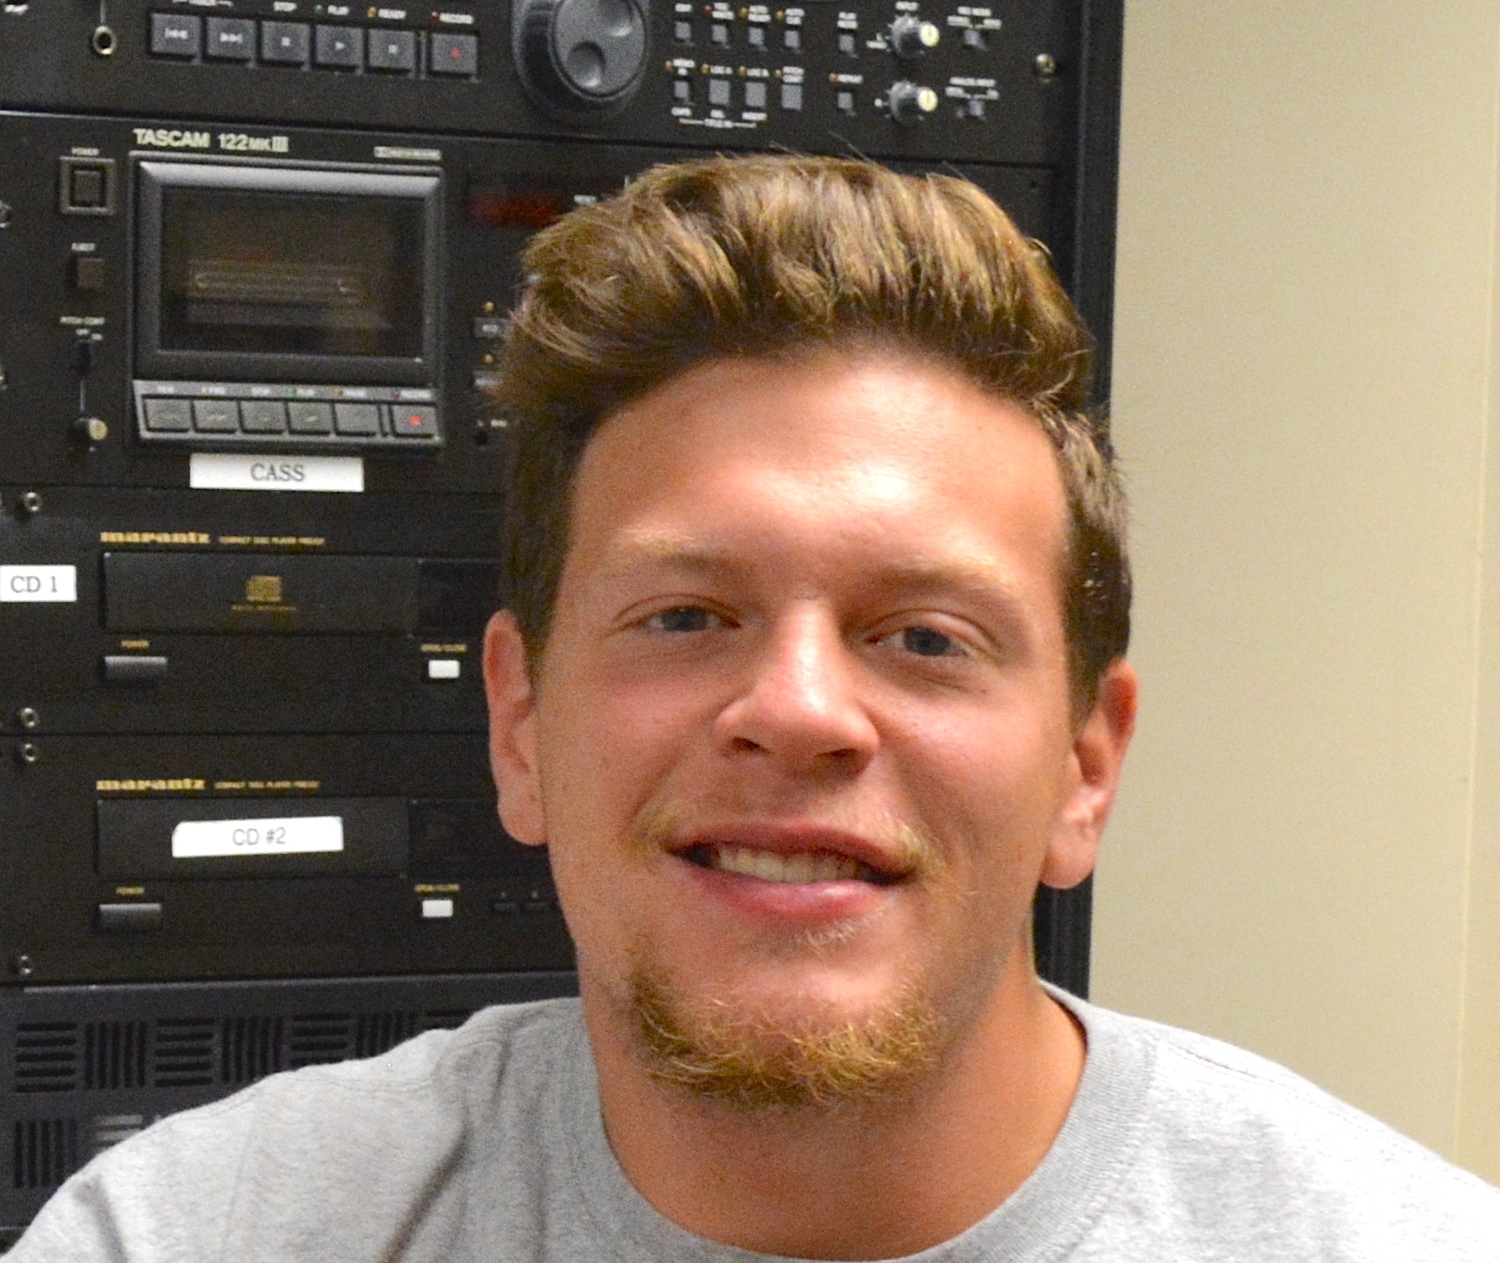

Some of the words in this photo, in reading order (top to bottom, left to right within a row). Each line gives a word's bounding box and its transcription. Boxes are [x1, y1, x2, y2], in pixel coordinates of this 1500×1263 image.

[133, 128, 210, 149] TASCAM
[250, 464, 306, 483] CASS
[101, 531, 210, 545] marantz
[10, 574, 41, 594] CD
[46, 575, 60, 593] 1
[96, 778, 206, 792] marantz
[231, 827, 261, 847] CD
[265, 826, 287, 846] #2
